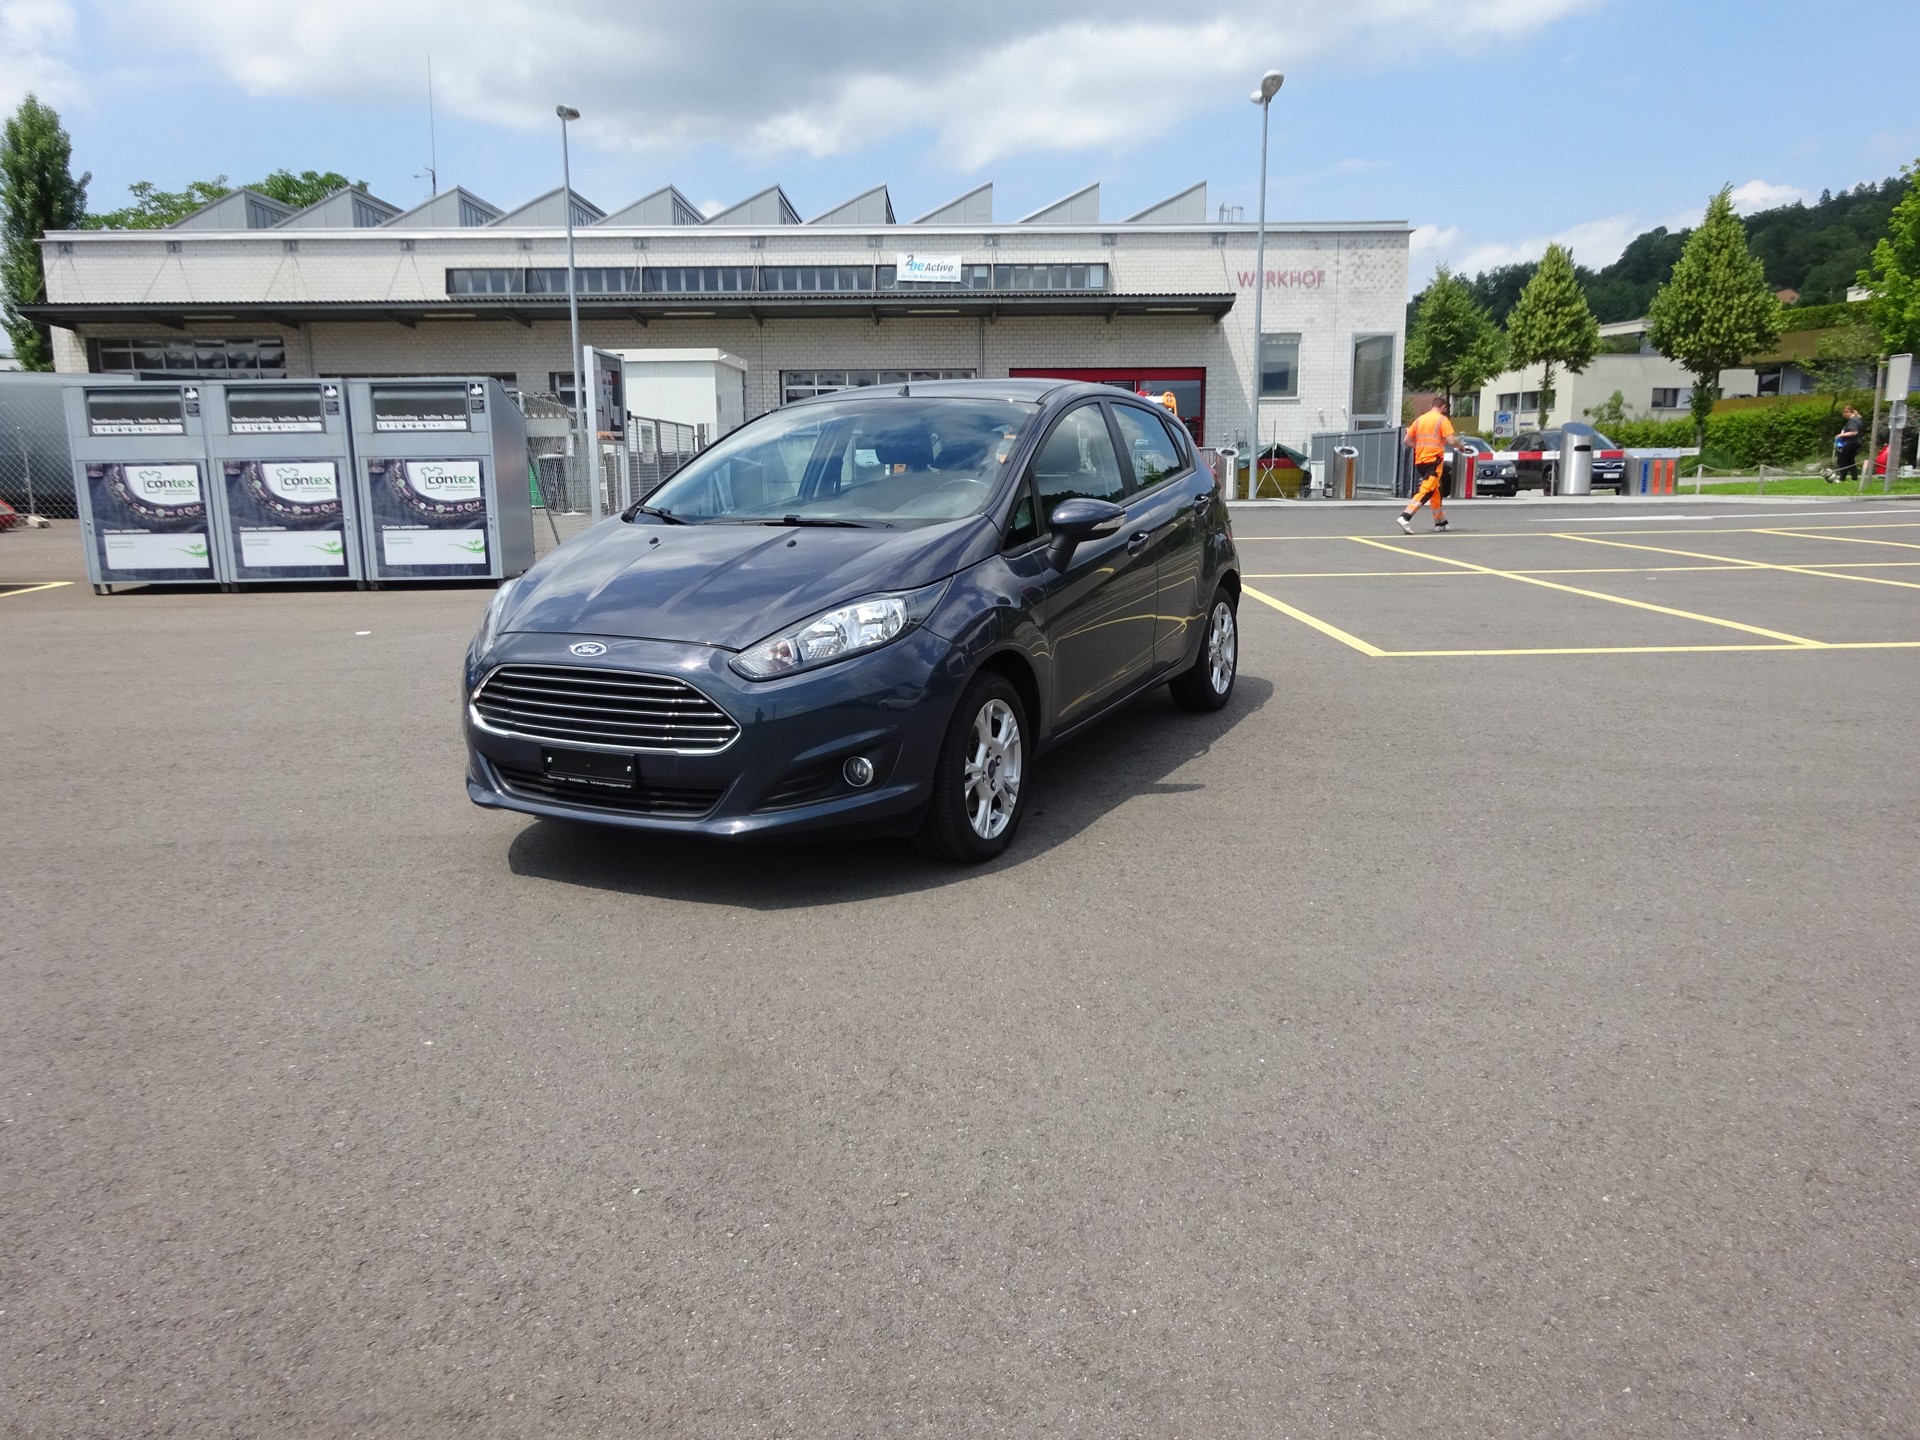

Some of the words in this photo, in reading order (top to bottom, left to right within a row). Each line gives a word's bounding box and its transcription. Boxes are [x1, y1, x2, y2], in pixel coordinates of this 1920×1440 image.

[925, 261, 954, 272] Active
[1237, 270, 1326, 288] WRKHOF
[147, 479, 195, 488] contex
[284, 476, 332, 486] contex
[428, 475, 476, 484] contex
